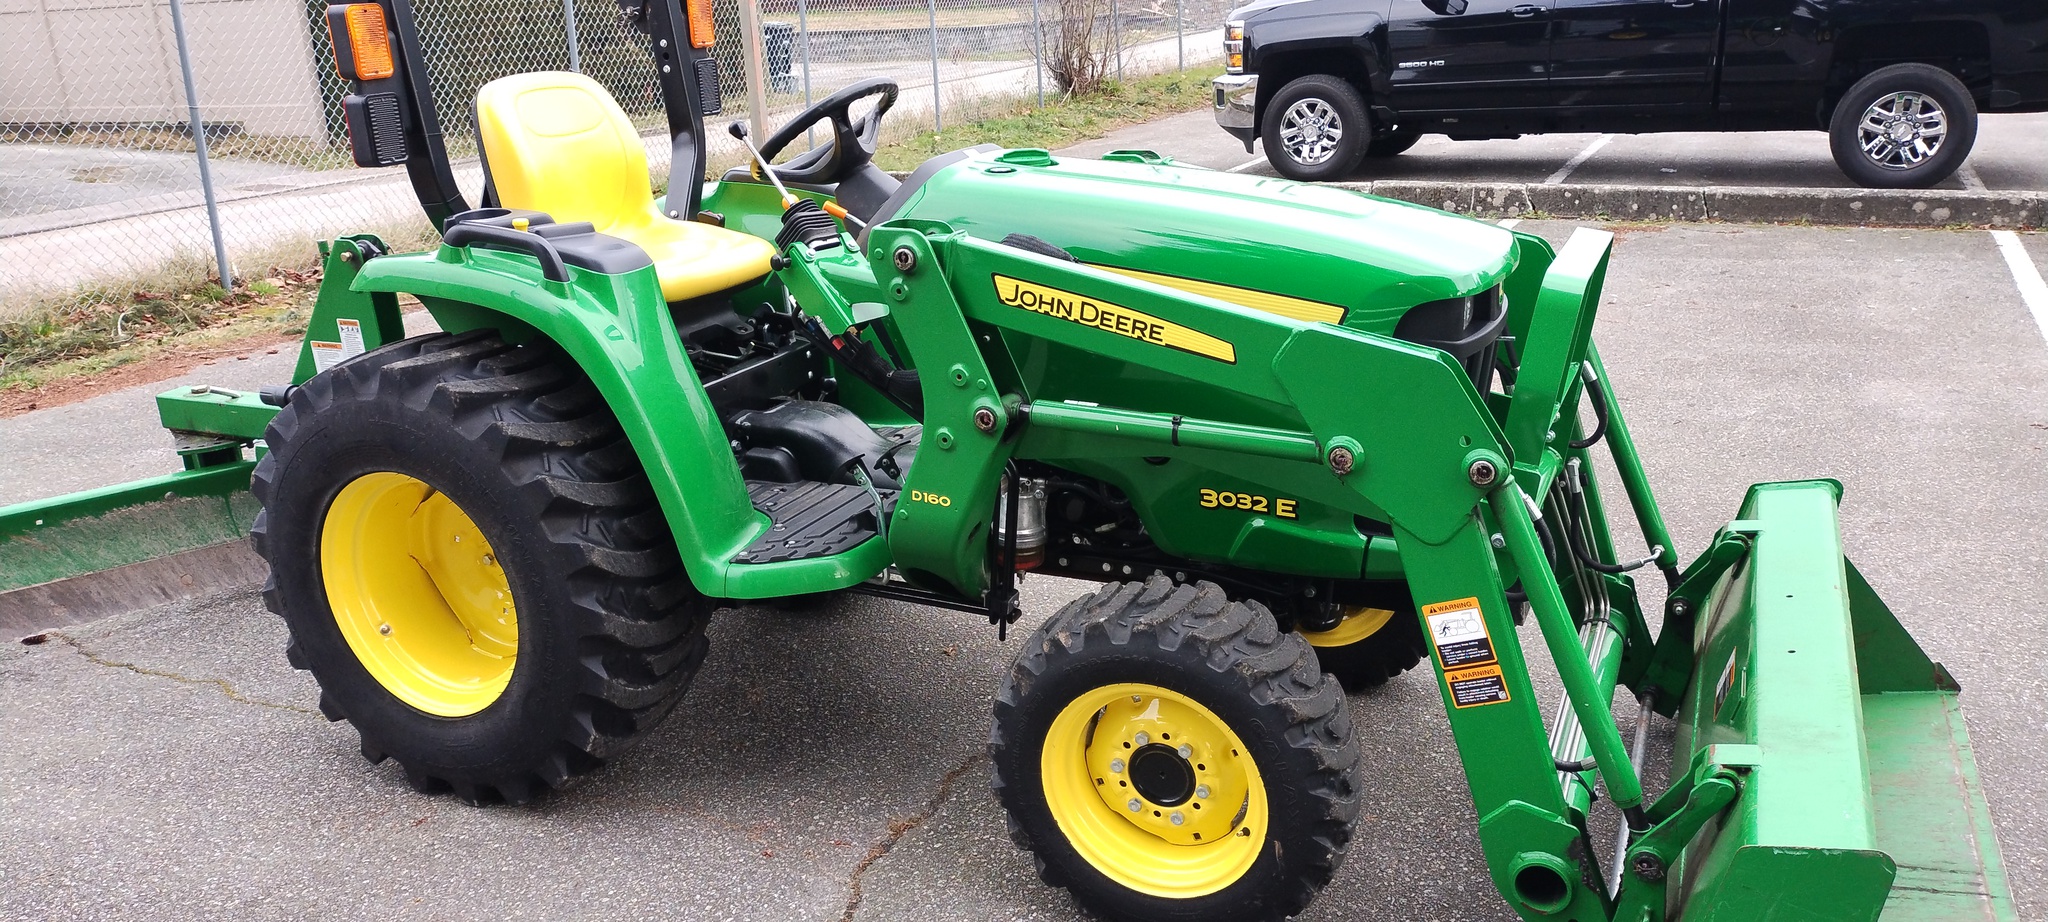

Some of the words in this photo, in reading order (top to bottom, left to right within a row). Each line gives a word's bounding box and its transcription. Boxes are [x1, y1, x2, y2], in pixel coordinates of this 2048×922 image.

[1005, 284, 1073, 317] JOHN
[1079, 301, 1165, 342] DEERE
[911, 490, 951, 507] D160
[1200, 488, 1268, 513] 3032
[1276, 498, 1297, 518] E
[1437, 601, 1472, 612] WARNING
[1460, 668, 1496, 679] WARNING
